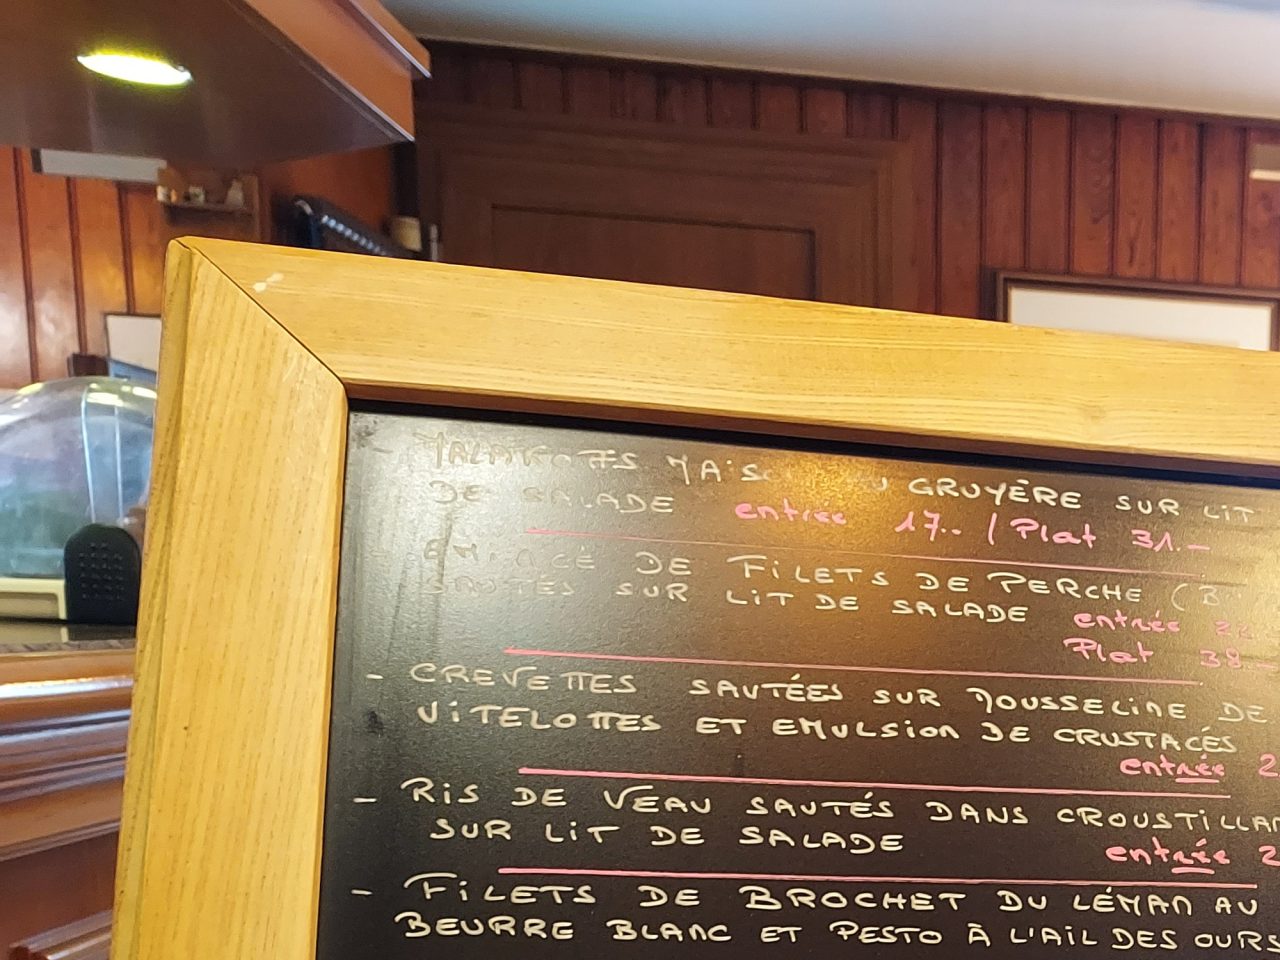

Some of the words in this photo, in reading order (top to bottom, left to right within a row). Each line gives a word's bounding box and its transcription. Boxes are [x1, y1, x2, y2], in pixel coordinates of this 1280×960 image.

[1115, 494, 1180, 518] SUR
[1010, 517, 1098, 549] Plat
[635, 551, 693, 576] DE
[915, 572, 970, 594] DE
[986, 571, 1144, 603] PERCHE
[615, 581, 691, 603] SUR
[815, 593, 860, 612] DE
[890, 598, 1030, 624] SALADE
[1062, 636, 1155, 666] Plat
[409, 661, 639, 695] CREVETTES
[687, 672, 845, 703] SAUTÉES
[872, 687, 943, 709] SUR
[1217, 701, 1270, 724] DE
[694, 715, 747, 736] ET
[980, 720, 1032, 743] DE
[1053, 725, 1239, 755] CRUSTACÉS
[510, 785, 569, 808] DE
[602, 784, 713, 816] VEAU
[745, 791, 896, 817] SAUTÉS
[925, 801, 1030, 826] DANS
[429, 818, 513, 842] SUR
[650, 824, 706, 847] DE
[738, 825, 905, 854] SALADE
[637, 885, 702, 908] DE
[738, 884, 968, 911] BROCHET
[996, 888, 1048, 914] DU
[1072, 885, 1194, 917] LÉMAN
[1214, 898, 1259, 917] AU
[394, 910, 576, 941] BEURRE
[605, 918, 733, 943] BLANC
[760, 925, 803, 944] ET
[828, 919, 943, 945] PESTO
[1110, 927, 1178, 951] DES
